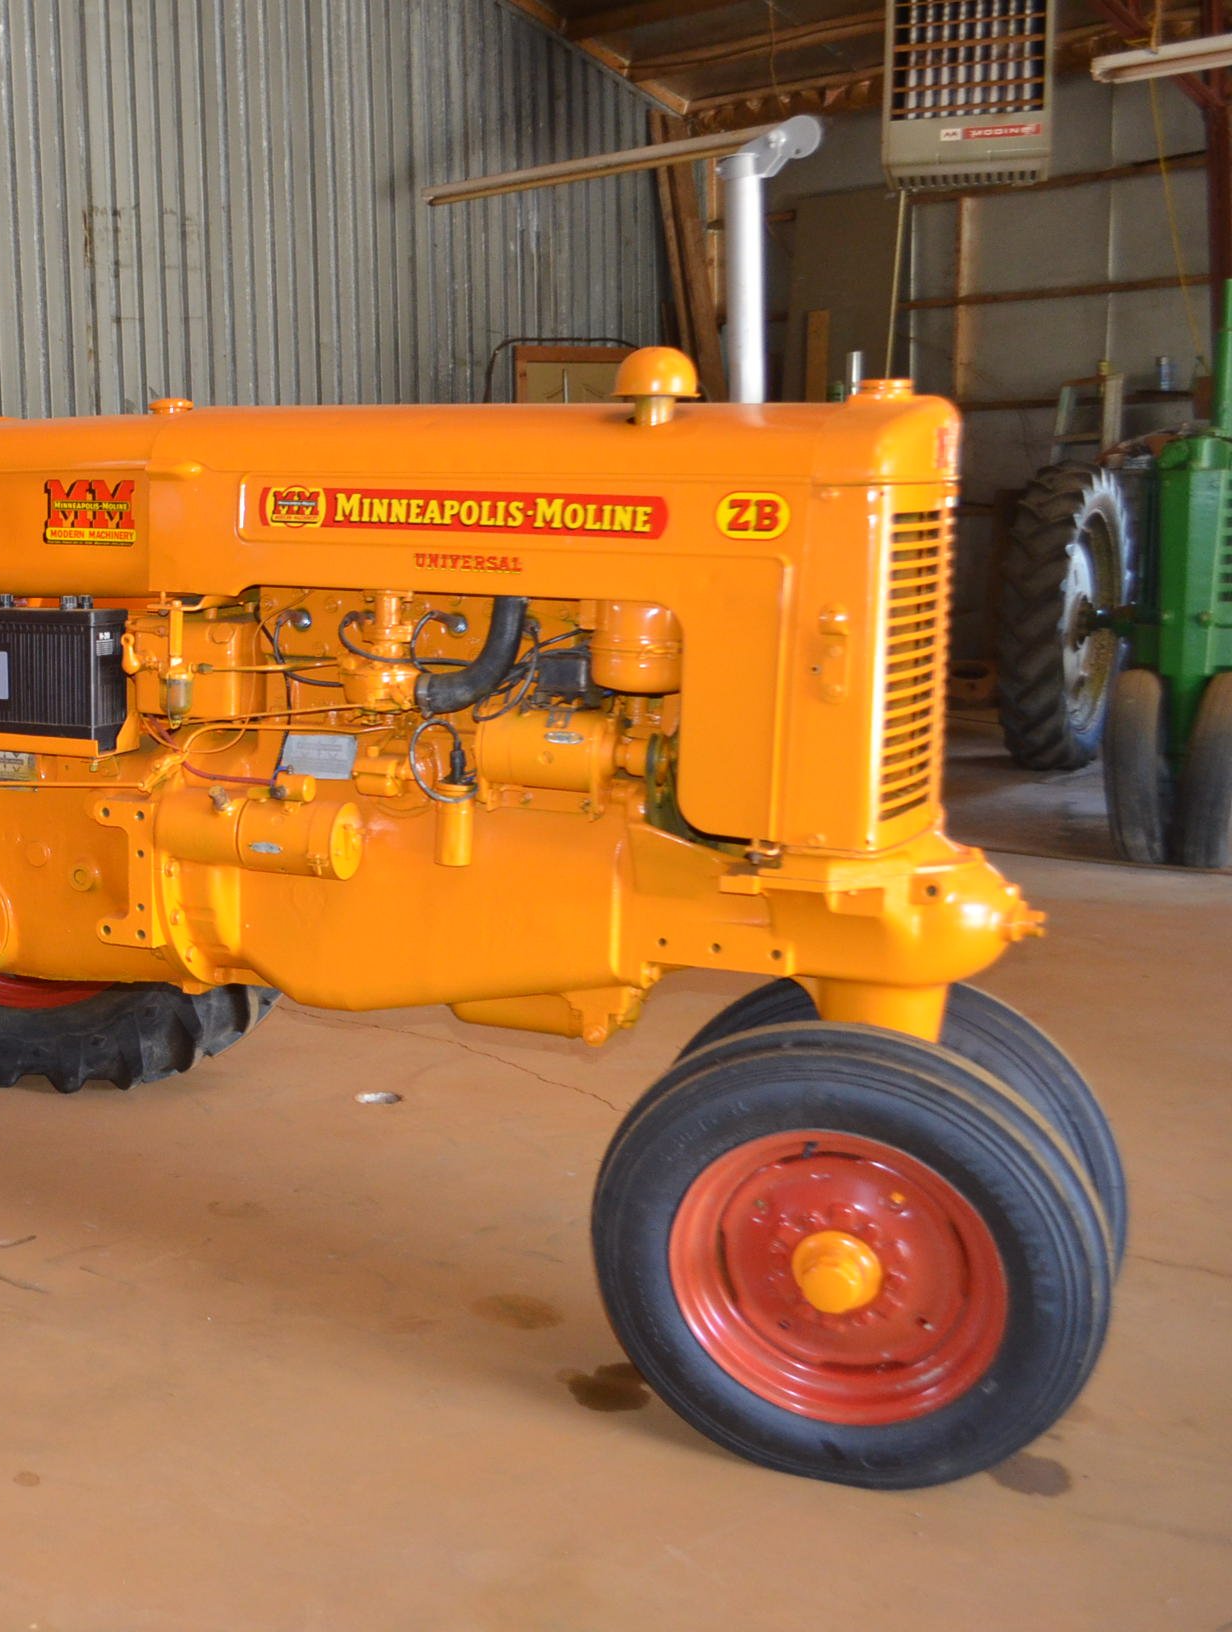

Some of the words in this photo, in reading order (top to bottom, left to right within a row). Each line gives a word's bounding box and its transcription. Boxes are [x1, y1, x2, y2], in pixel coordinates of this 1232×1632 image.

[54, 501, 128, 511] MINNEAPOLIS-MOLINE
[334, 493, 653, 532] MINNEAPOLIS-MOLINE
[727, 498, 780, 532] ZB
[50, 529, 85, 539] MODERN
[88, 530, 134, 540] MACHINERY
[414, 552, 522, 573] UNIVERSAL
